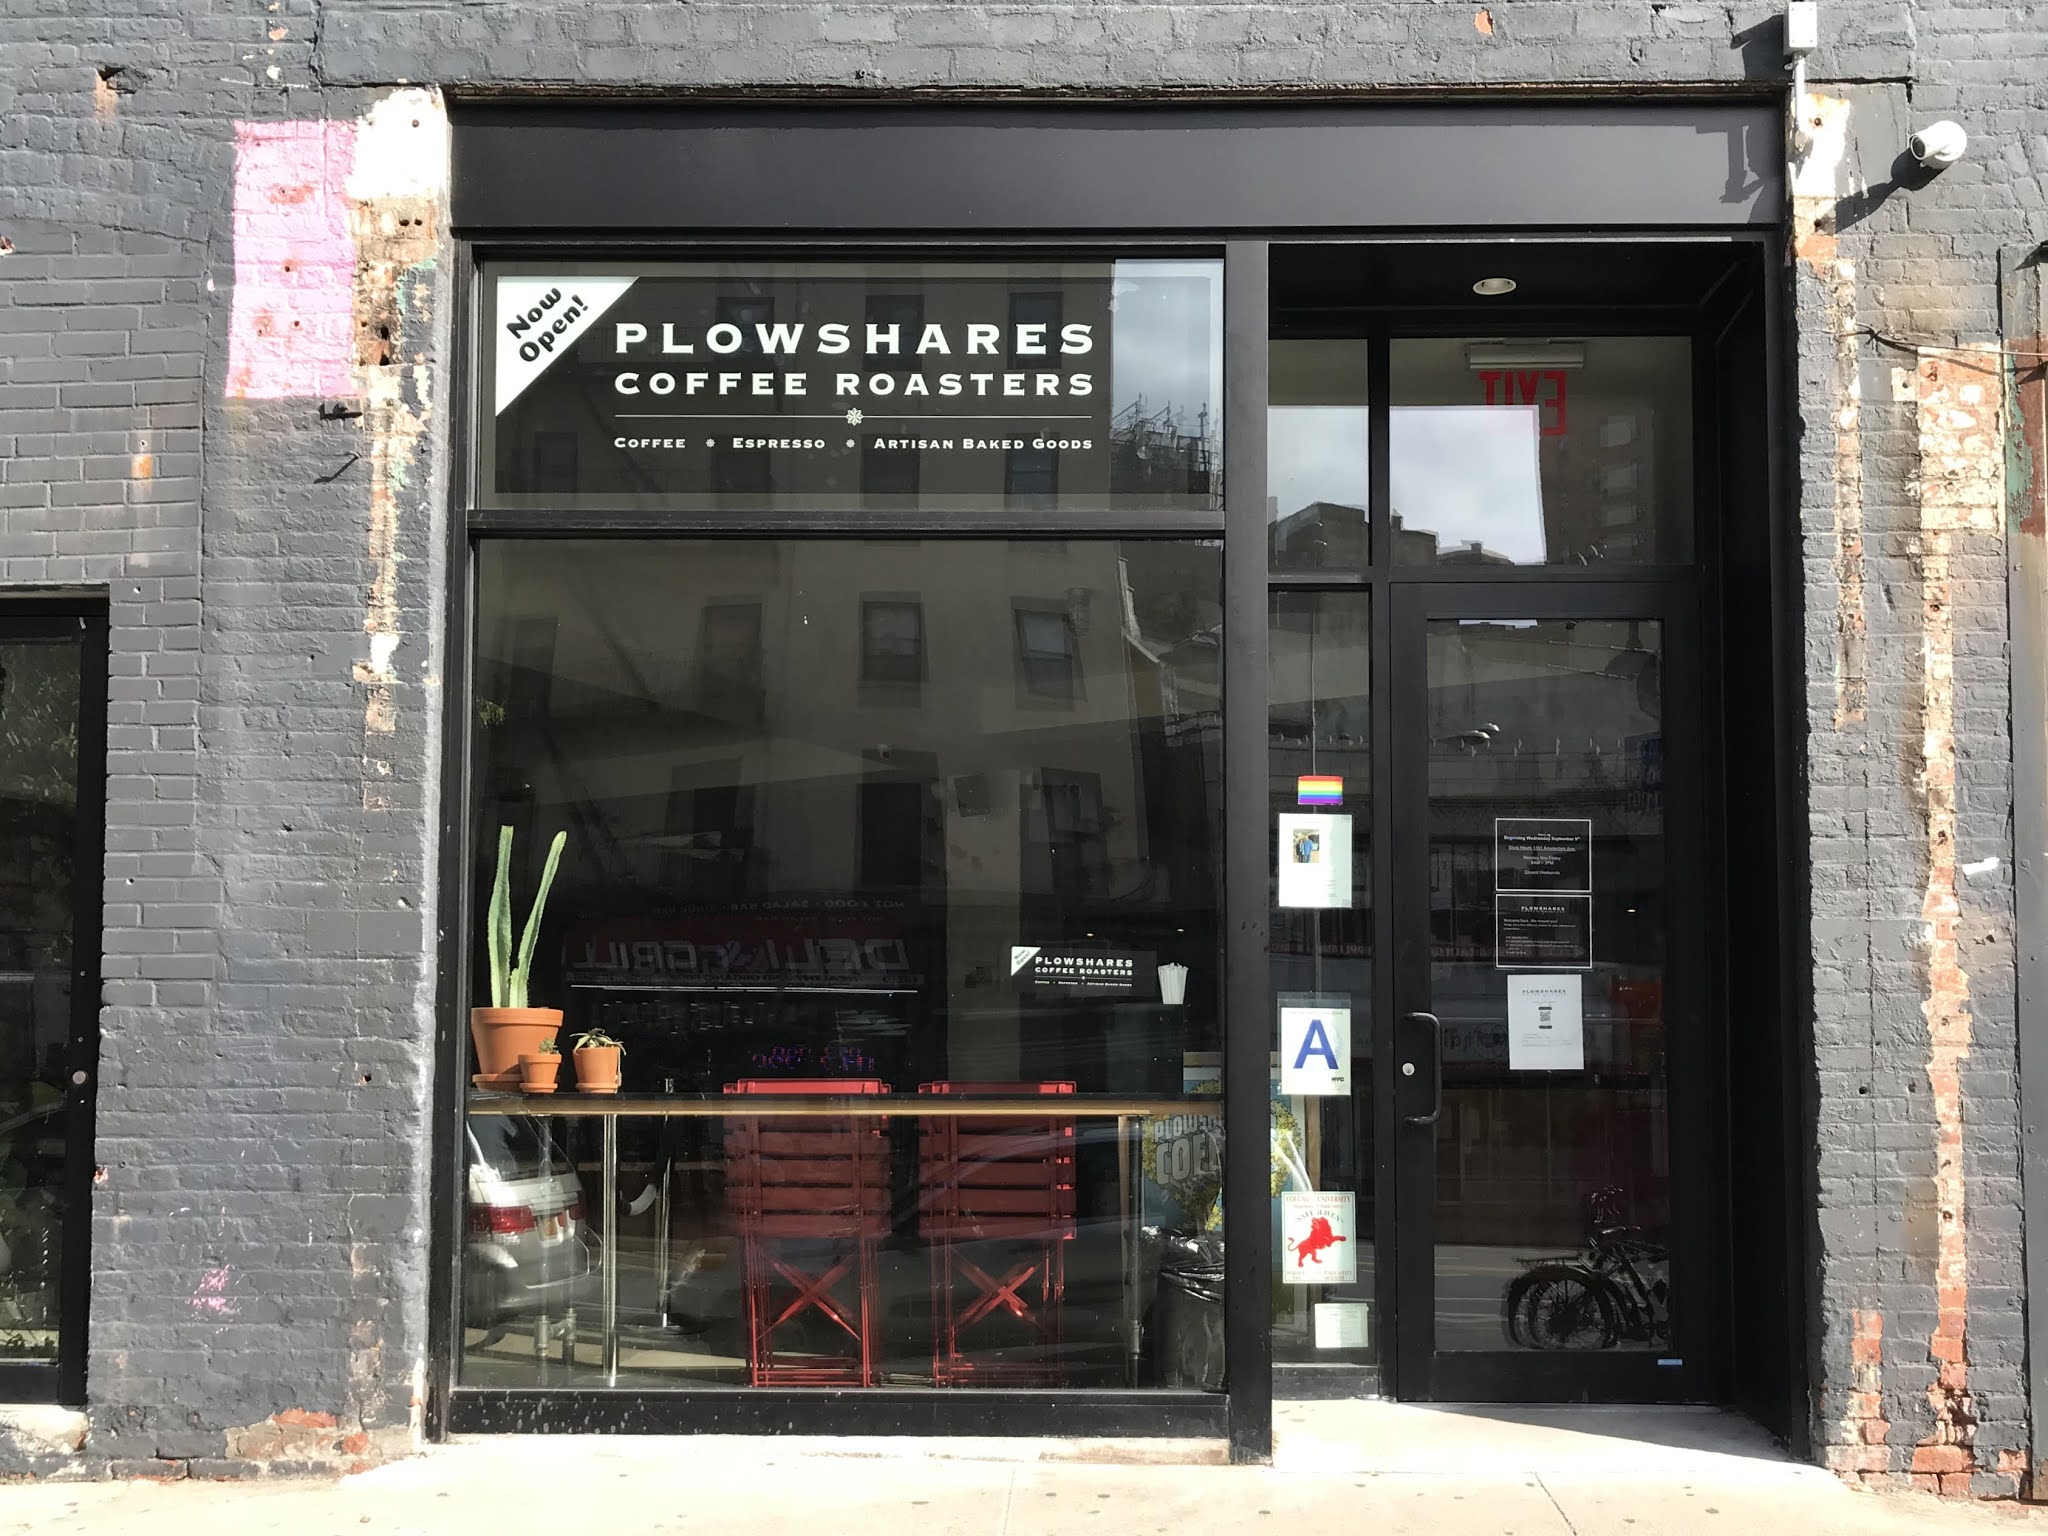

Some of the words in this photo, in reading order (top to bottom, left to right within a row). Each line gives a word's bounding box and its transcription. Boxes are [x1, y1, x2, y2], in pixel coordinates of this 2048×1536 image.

[506, 287, 562, 339] Now
[519, 294, 588, 362] Open!
[615, 322, 1093, 355] PLOWSHARES
[614, 372, 807, 396] COFFEE
[835, 373, 1093, 396] ROASTERS
[1035, 957, 1133, 967] PLOWSHARES
[1035, 967, 1075, 975] COFFEE
[1079, 968, 1133, 976] ROASTERS
[1293, 1019, 1339, 1070] A
